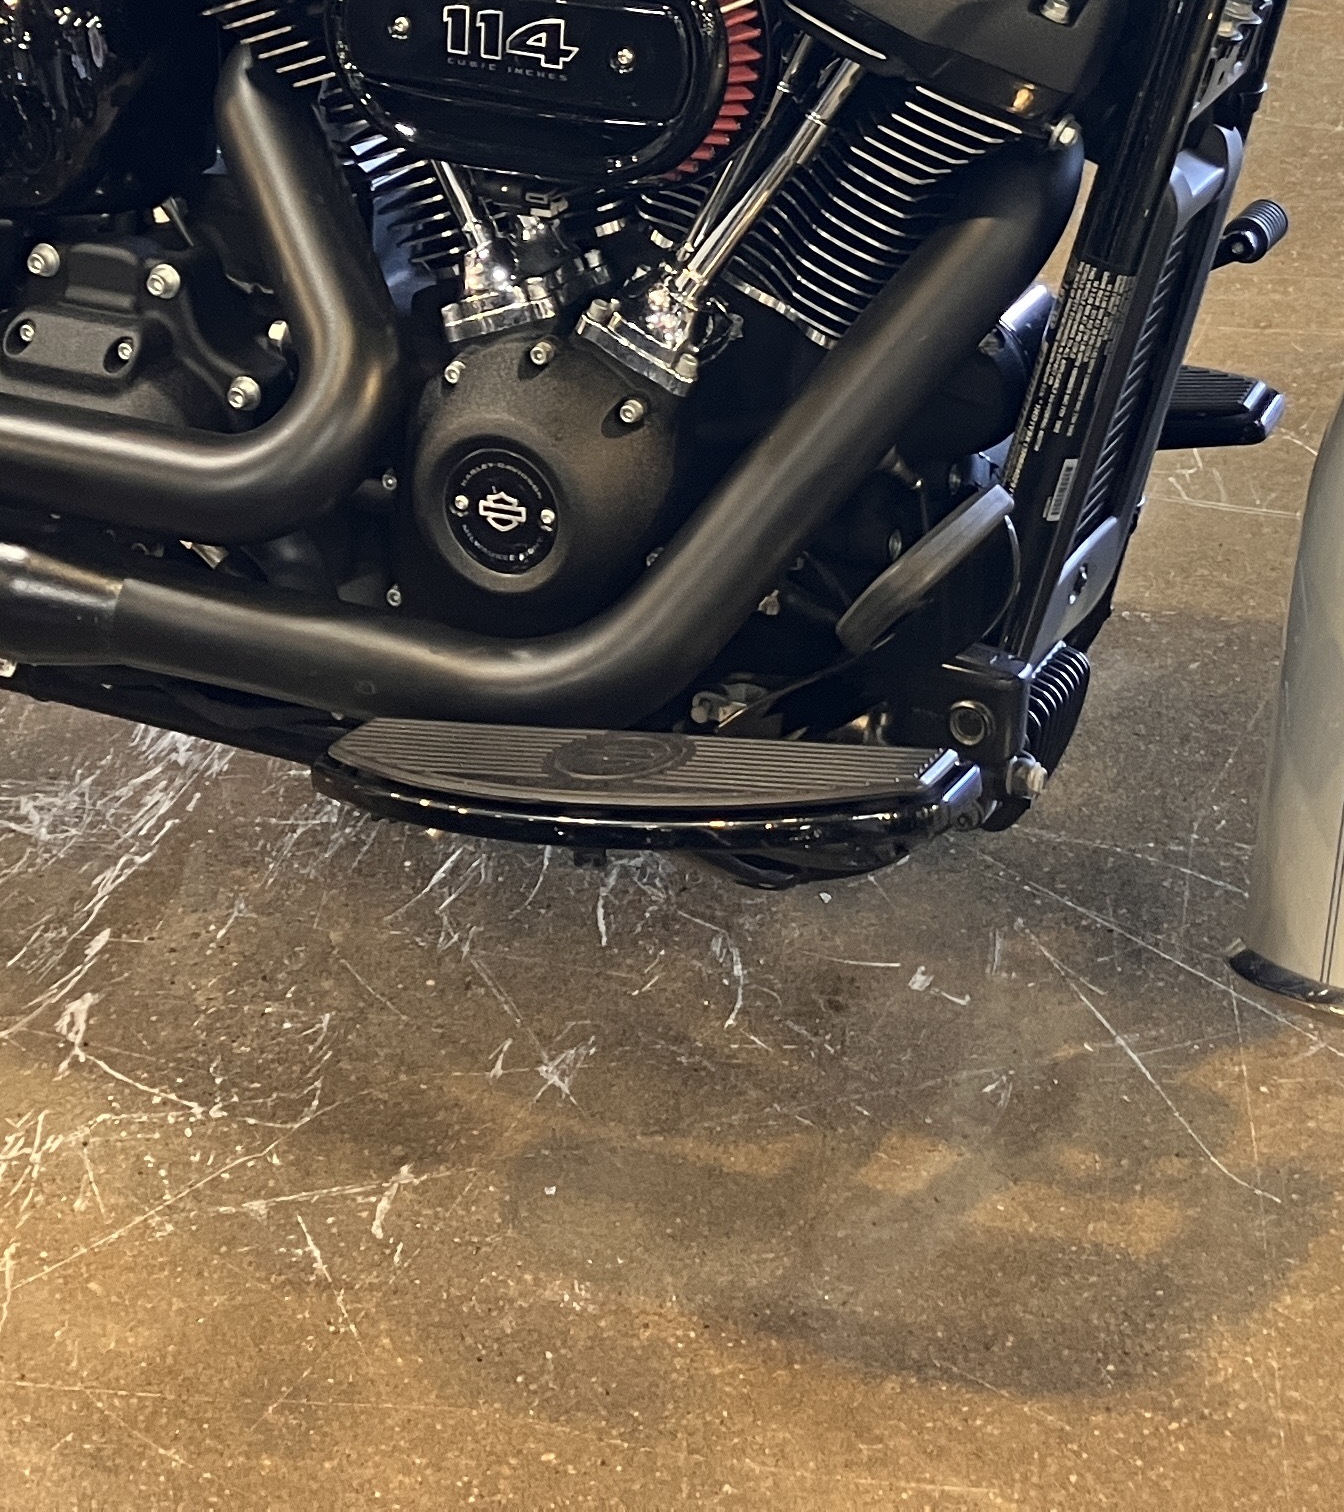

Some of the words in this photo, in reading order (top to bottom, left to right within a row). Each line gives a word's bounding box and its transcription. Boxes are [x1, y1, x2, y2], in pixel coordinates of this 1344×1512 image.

[442, 4, 580, 70] 114
[447, 56, 497, 72] CUBIC
[507, 66, 568, 82] INCHES
